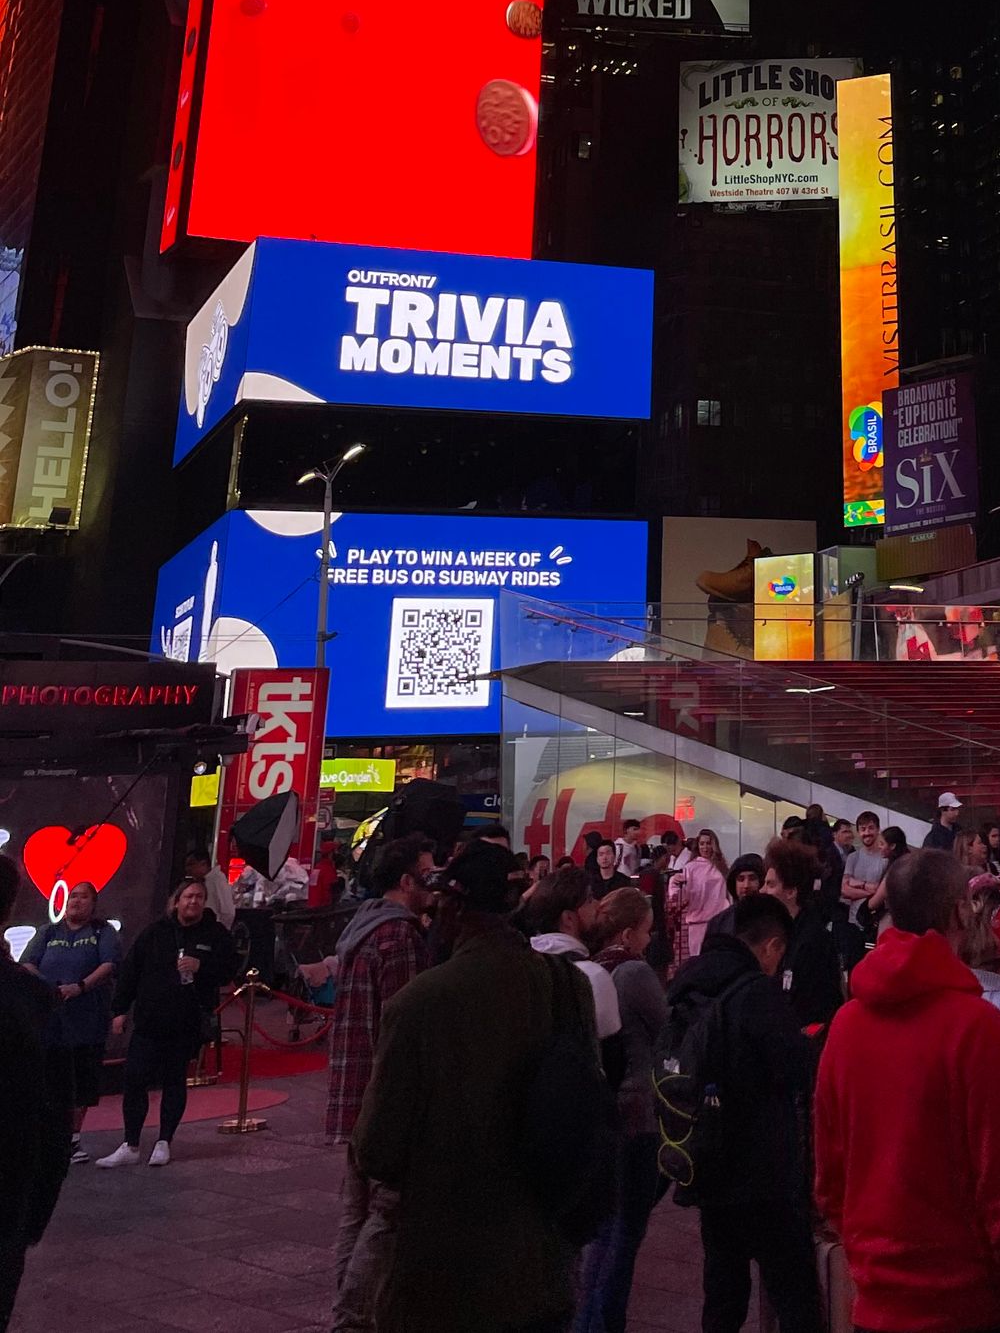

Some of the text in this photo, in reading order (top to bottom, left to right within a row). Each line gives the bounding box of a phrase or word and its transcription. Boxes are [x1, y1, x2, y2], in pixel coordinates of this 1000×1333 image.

[699, 65, 782, 109] LITTLE
[762, 97, 779, 107] OF
[697, 111, 839, 186] HORRORS
[709, 186, 829, 198] Westside Theatre 407 W 43rd St
[724, 173, 819, 186] LittleShopNYC.com
[344, 285, 573, 349] TRIVIA
[339, 335, 573, 384] MOMENTS
[897, 378, 957, 407] BROADWAY'S
[28, 359, 83, 519] HELLO!
[866, 414, 878, 455] BRASIL
[347, 548, 541, 567] PLAY TO WIN A WEEK OF
[327, 568, 561, 586] FREE BUS OR SUBWAY RIDES
[1, 685, 199, 706] PHOTOGRAPHY
[248, 676, 314, 800] tkts
